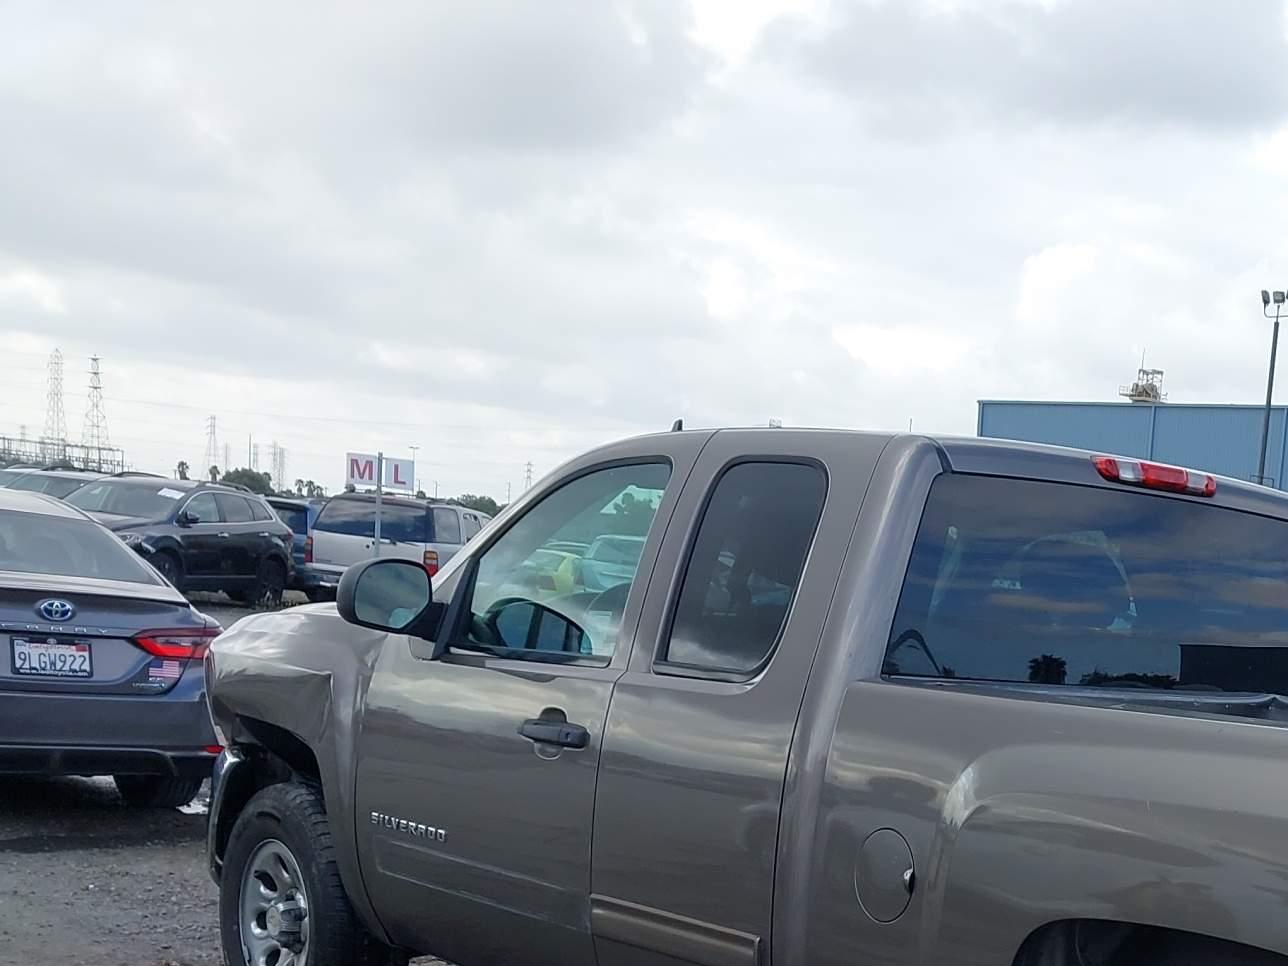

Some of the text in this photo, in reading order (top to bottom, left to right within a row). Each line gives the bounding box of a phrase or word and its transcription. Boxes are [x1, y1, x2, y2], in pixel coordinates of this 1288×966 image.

[350, 458, 374, 481] M
[393, 463, 407, 485] L
[17, 651, 87, 672] 9LGW922
[371, 811, 447, 842] SILVERADO
